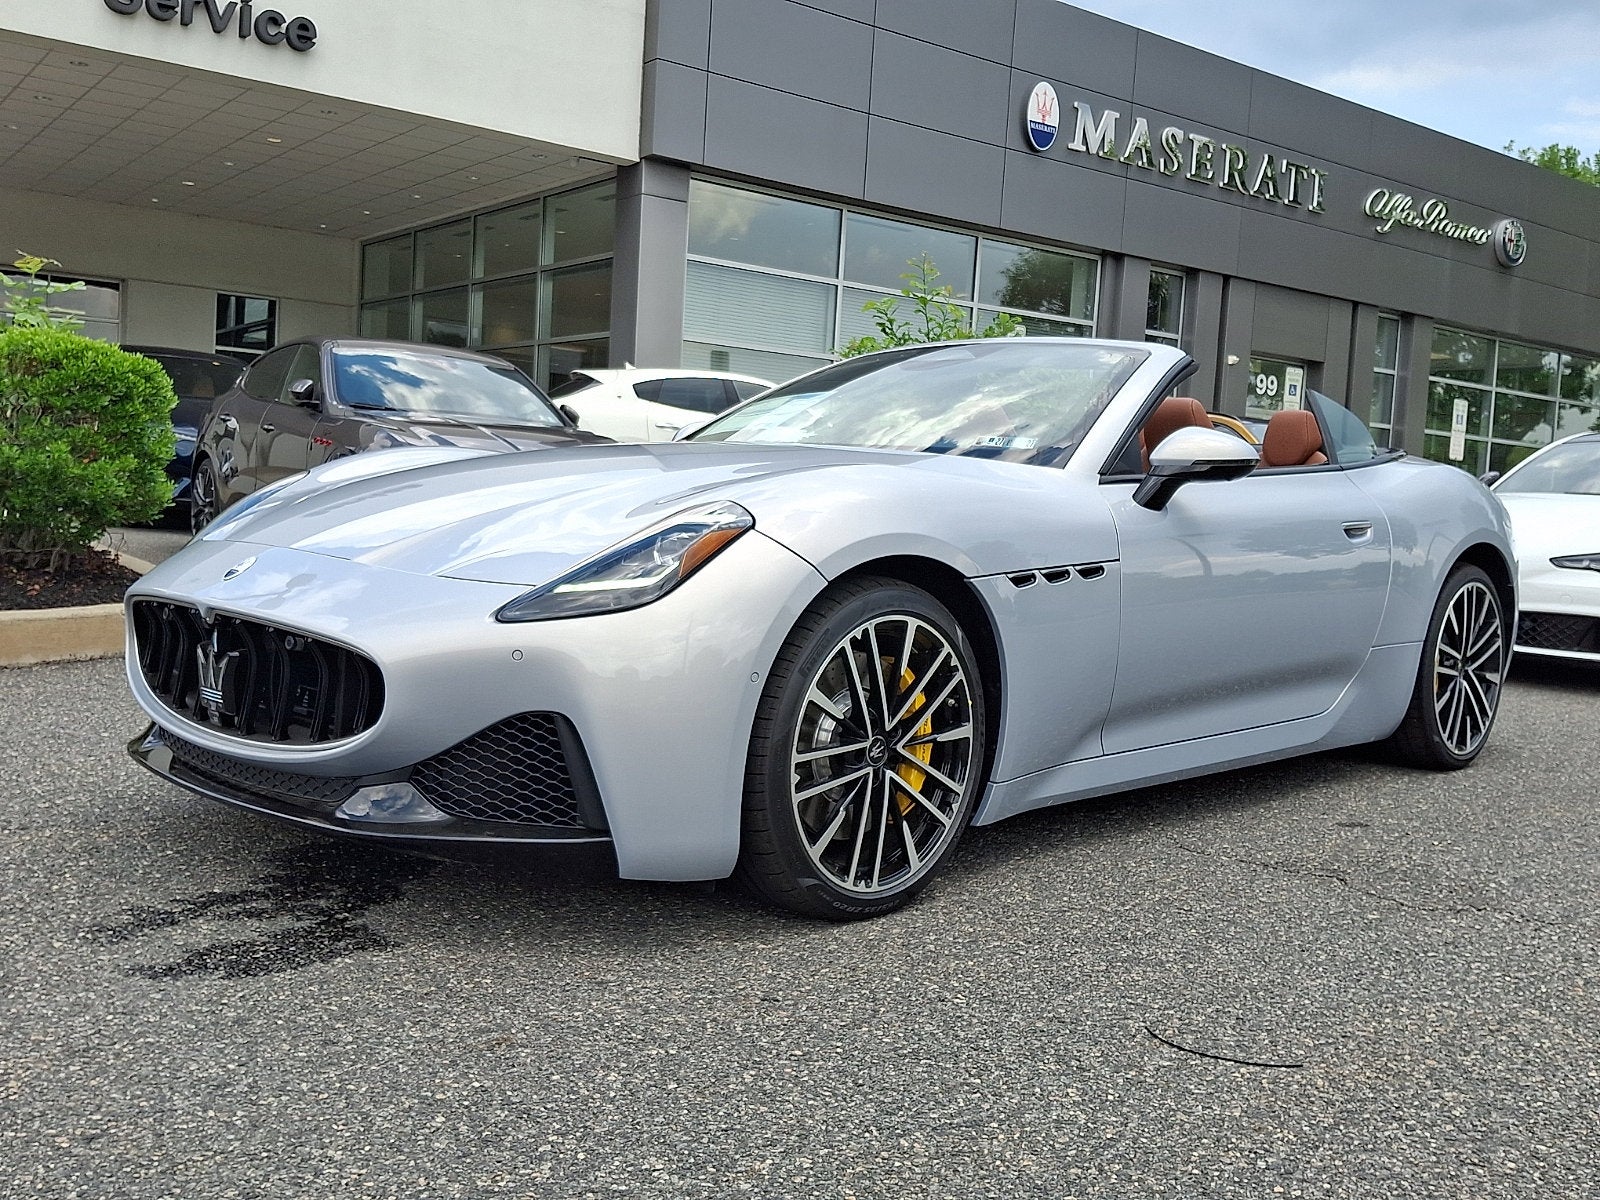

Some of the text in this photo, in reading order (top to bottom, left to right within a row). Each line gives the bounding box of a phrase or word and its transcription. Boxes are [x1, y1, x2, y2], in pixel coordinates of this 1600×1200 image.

[1030, 121, 1056, 134] MASERATI
[1068, 102, 1329, 214] MASERATI
[1364, 188, 1493, 245] Alfa Romeo
[1256, 373, 1278, 397] 99
